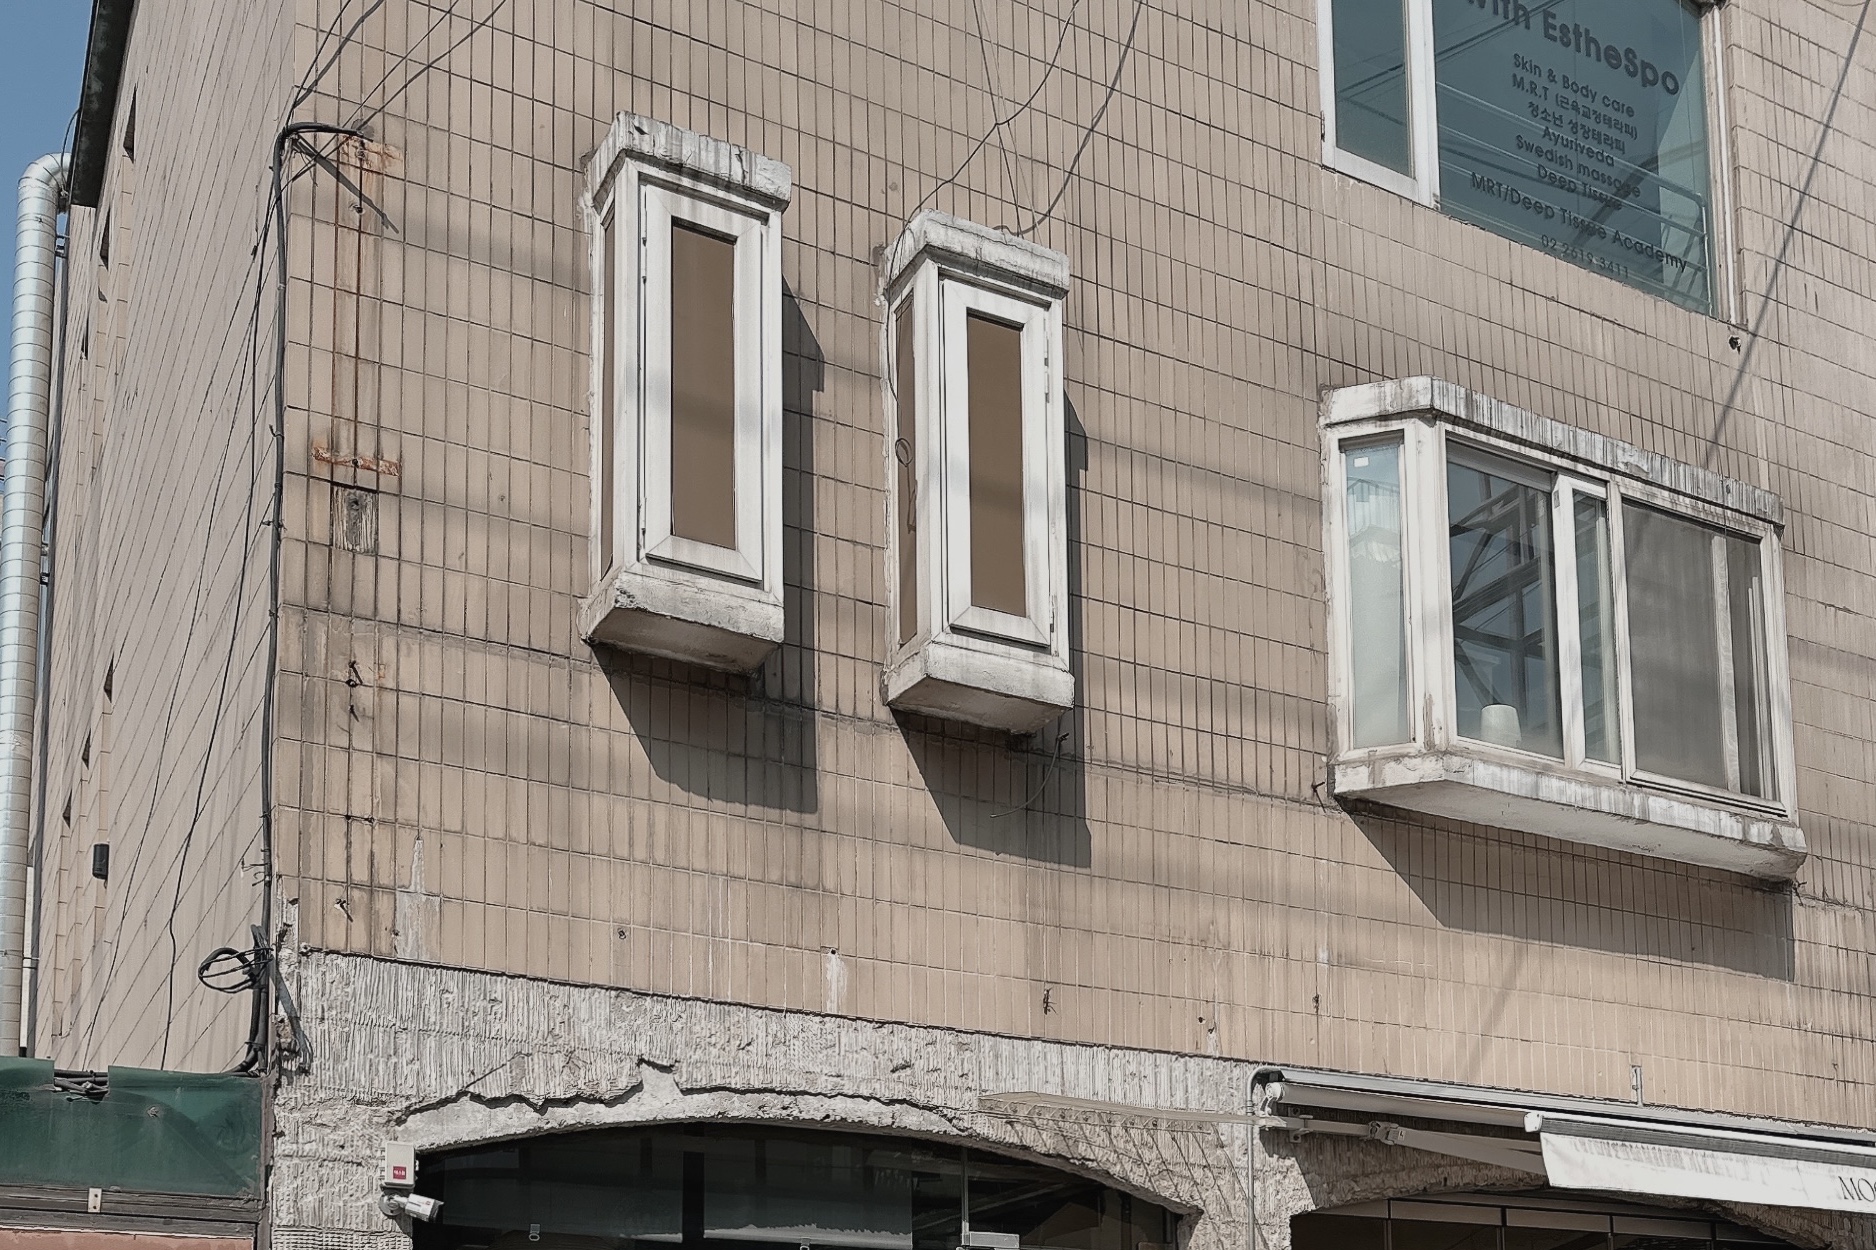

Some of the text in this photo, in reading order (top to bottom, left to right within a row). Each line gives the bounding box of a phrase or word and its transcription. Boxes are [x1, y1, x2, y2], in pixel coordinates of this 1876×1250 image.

[1512, 73, 1549, 100] M.R.T
[1513, 53, 1635, 118] Skin & Body care
[1528, 101, 1626, 155] 청소년 성장테라피
[1516, 134, 1573, 170] Swedish
[1537, 163, 1577, 193] Deep
[1471, 171, 1555, 219] MRT/Deep
[1612, 229, 1688, 274] Academy
[1838, 1176, 1876, 1203] MO
